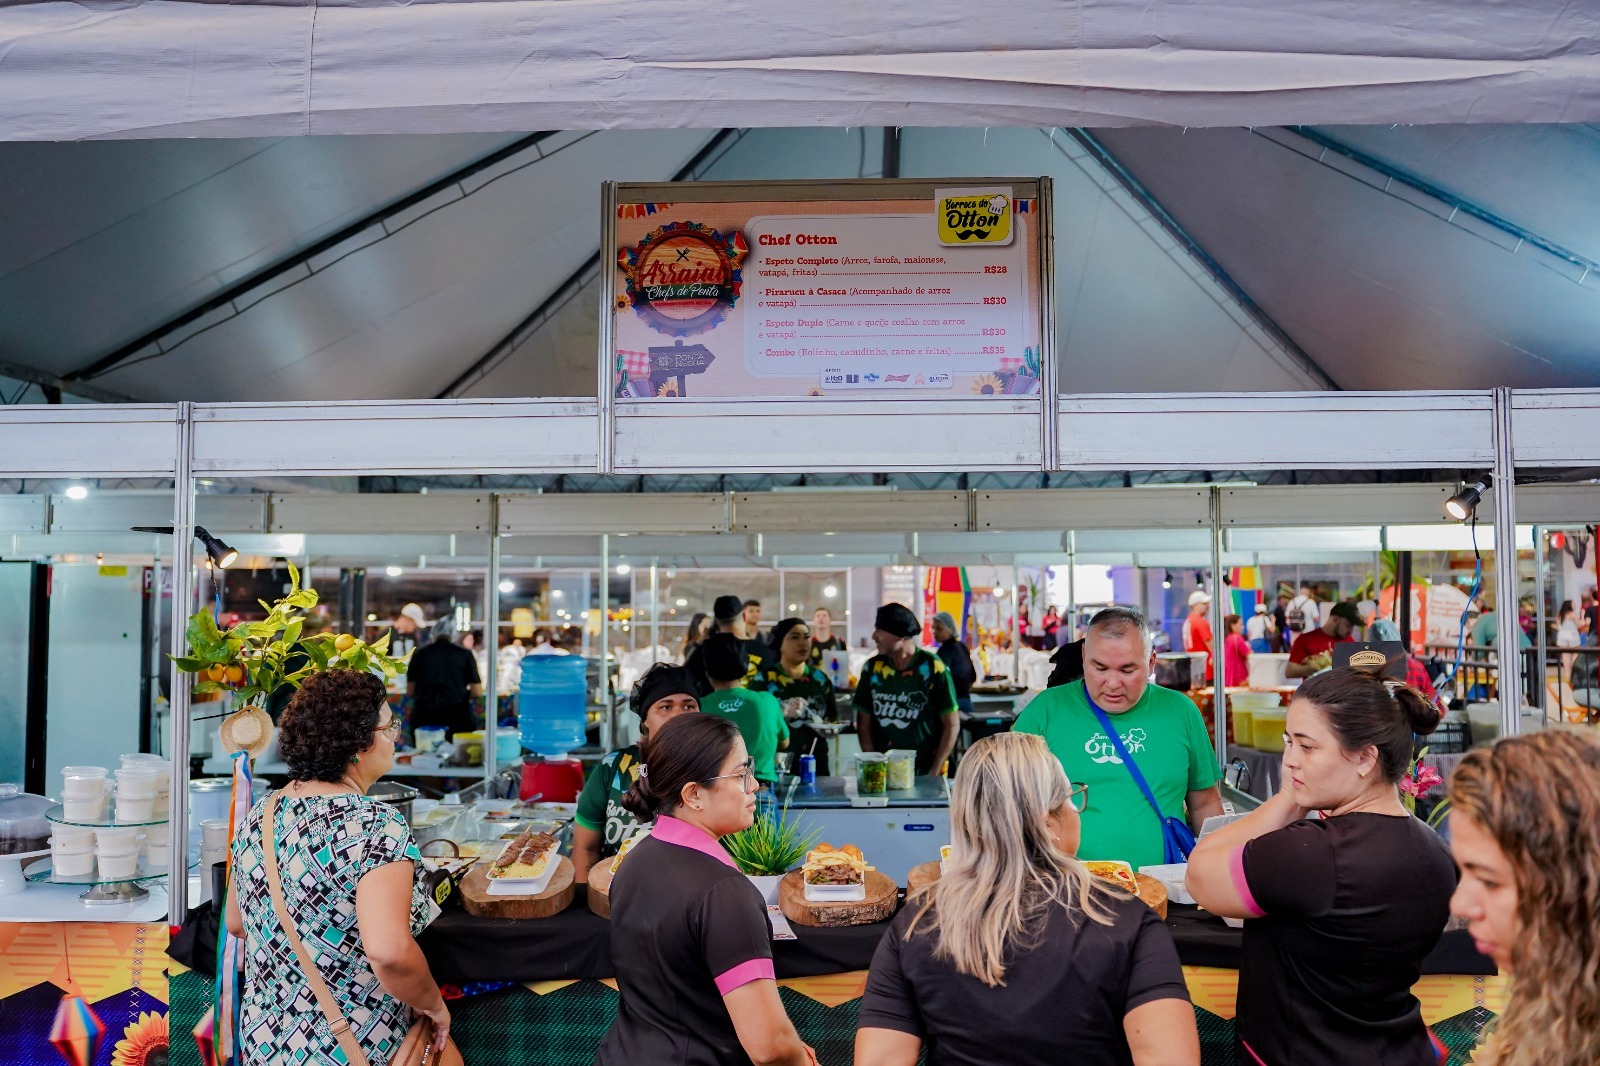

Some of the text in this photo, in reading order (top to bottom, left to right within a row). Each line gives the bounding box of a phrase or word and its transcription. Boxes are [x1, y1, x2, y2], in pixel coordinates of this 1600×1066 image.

[979, 199, 988, 208] do
[946, 209, 999, 229] Otton
[758, 234, 838, 246] Chef Otton
[765, 255, 946, 267] Espeto Completo (Arroz, farofa, maionese,
[638, 258, 727, 284] Arraial
[758, 267, 818, 278] vatapá, fritas)
[984, 265, 1008, 275] R$28
[645, 282, 720, 301] Chefs de Ponta
[765, 288, 806, 296] Pirarucu
[816, 287, 847, 296] Casaca
[849, 286, 913, 297] (Acompanhado
[915, 286, 926, 295] de
[766, 299, 797, 309] vatapá)
[983, 297, 1007, 306] R$30
[765, 319, 794, 329] Espeto
[797, 318, 824, 328] Duplo
[826, 318, 855, 328] (Carne
[864, 318, 889, 328] queijo
[891, 317, 920, 326] coalho
[982, 328, 1006, 337] R$30
[765, 348, 796, 357] Combo
[798, 348, 838, 358] (Bolinho,
[840, 347, 888, 357] canudinho,
[925, 346, 952, 357] fritas)
[982, 346, 1005, 355] R$35
[675, 353, 705, 361] PONTA
[675, 360, 705, 368] NEGRA
[873, 700, 920, 719] Otton
